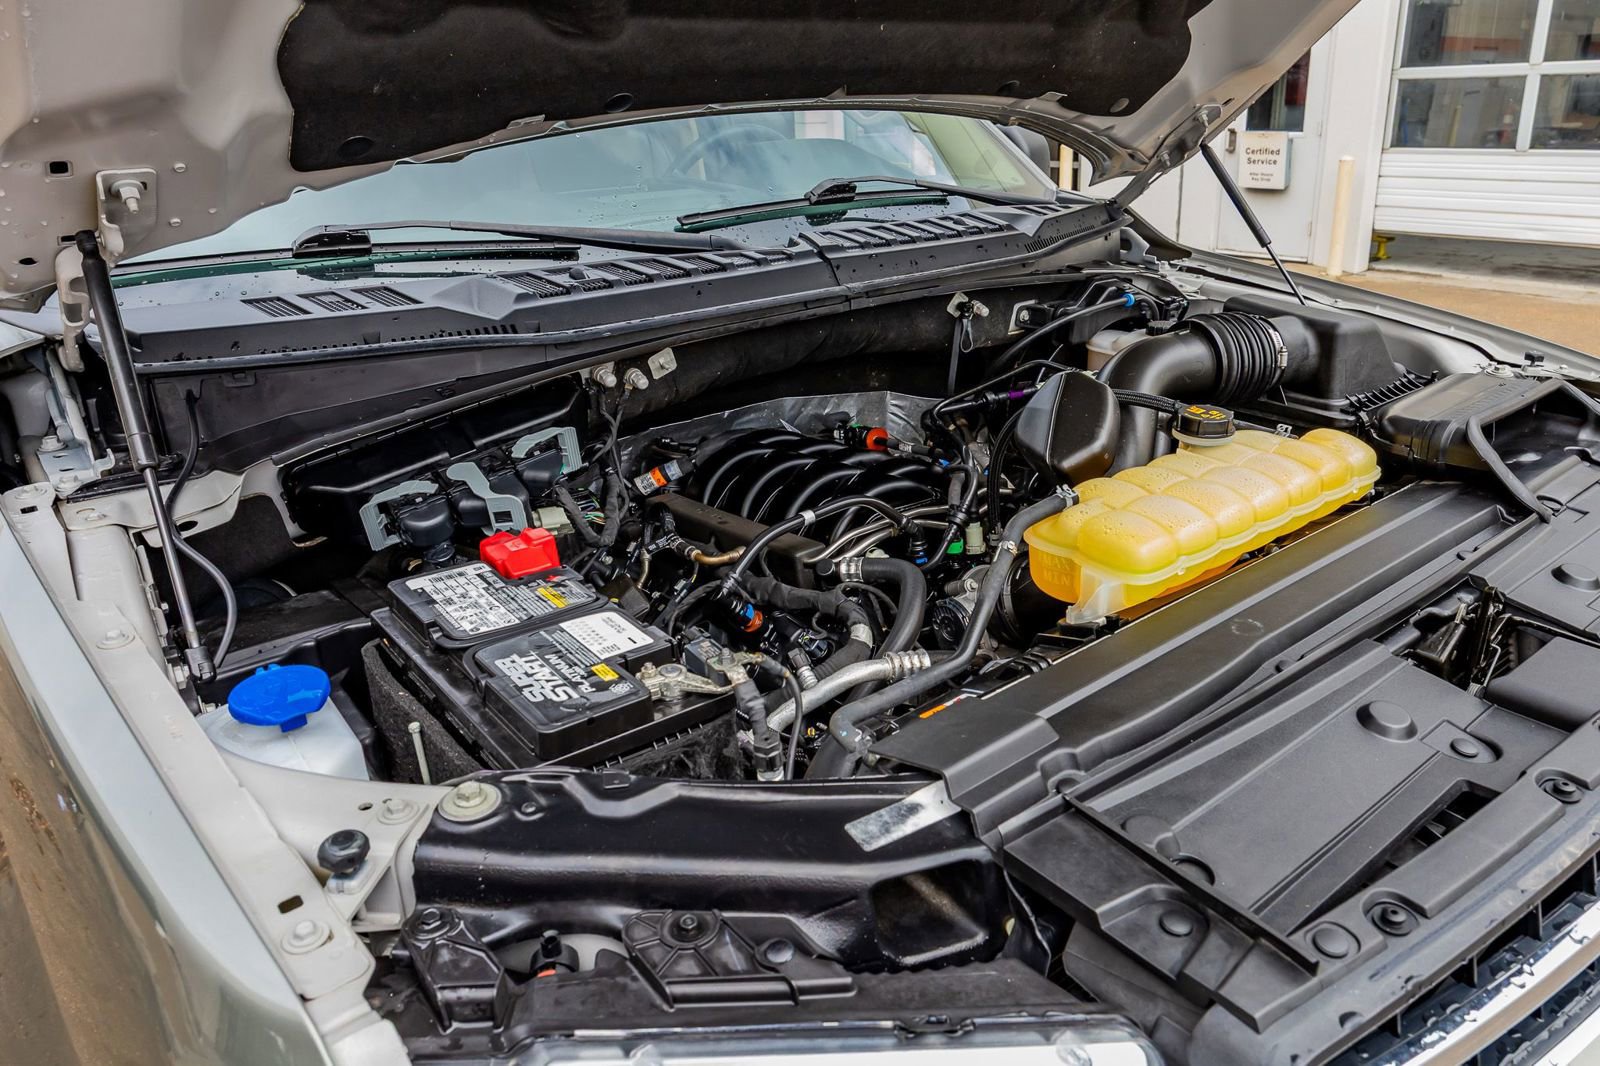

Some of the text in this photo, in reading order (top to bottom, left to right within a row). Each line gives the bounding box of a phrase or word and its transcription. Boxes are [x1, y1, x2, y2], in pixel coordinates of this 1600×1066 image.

[1245, 147, 1281, 156] Certified
[1247, 157, 1278, 166] Service
[494, 658, 545, 702] SUPER
[510, 653, 580, 702] START
[544, 654, 596, 693] PLATINUM
